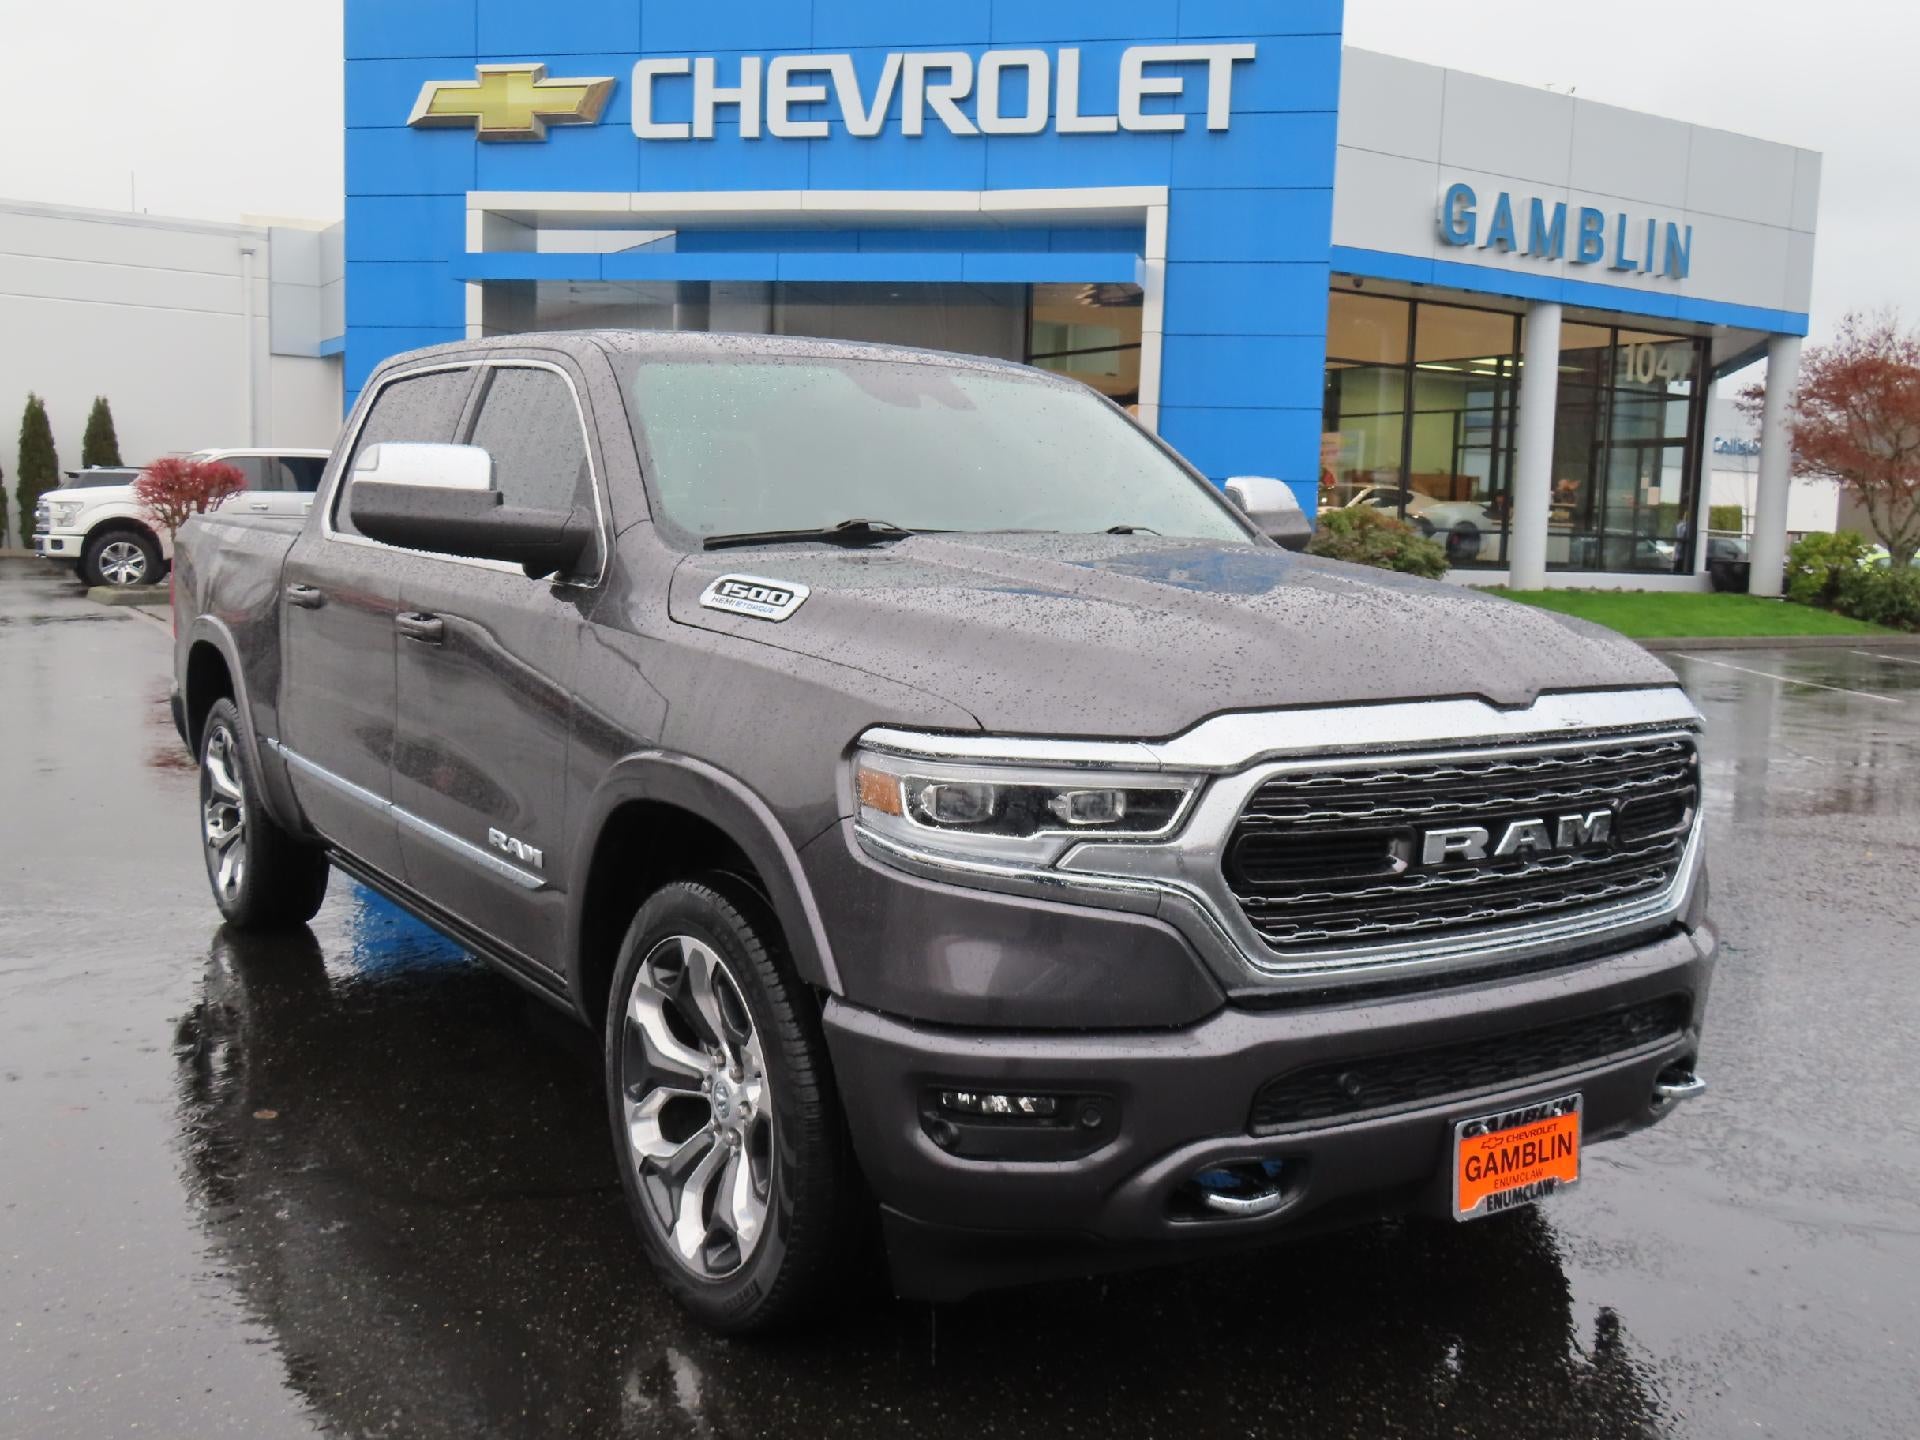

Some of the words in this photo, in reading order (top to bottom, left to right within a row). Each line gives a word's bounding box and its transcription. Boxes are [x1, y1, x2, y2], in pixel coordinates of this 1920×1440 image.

[631, 43, 1256, 140] CHEVROLET
[1440, 182, 1692, 280] GAMBLIN
[720, 582, 790, 606] 1500
[488, 827, 543, 869] RAM
[1422, 809, 1613, 865] RAM
[1506, 1122, 1559, 1145] CHEVROLET
[1464, 1130, 1573, 1183] GAMBLIN
[1486, 1177, 1556, 1213] ENUMCLAW
[1493, 1167, 1545, 1190] ENUMCLAW
